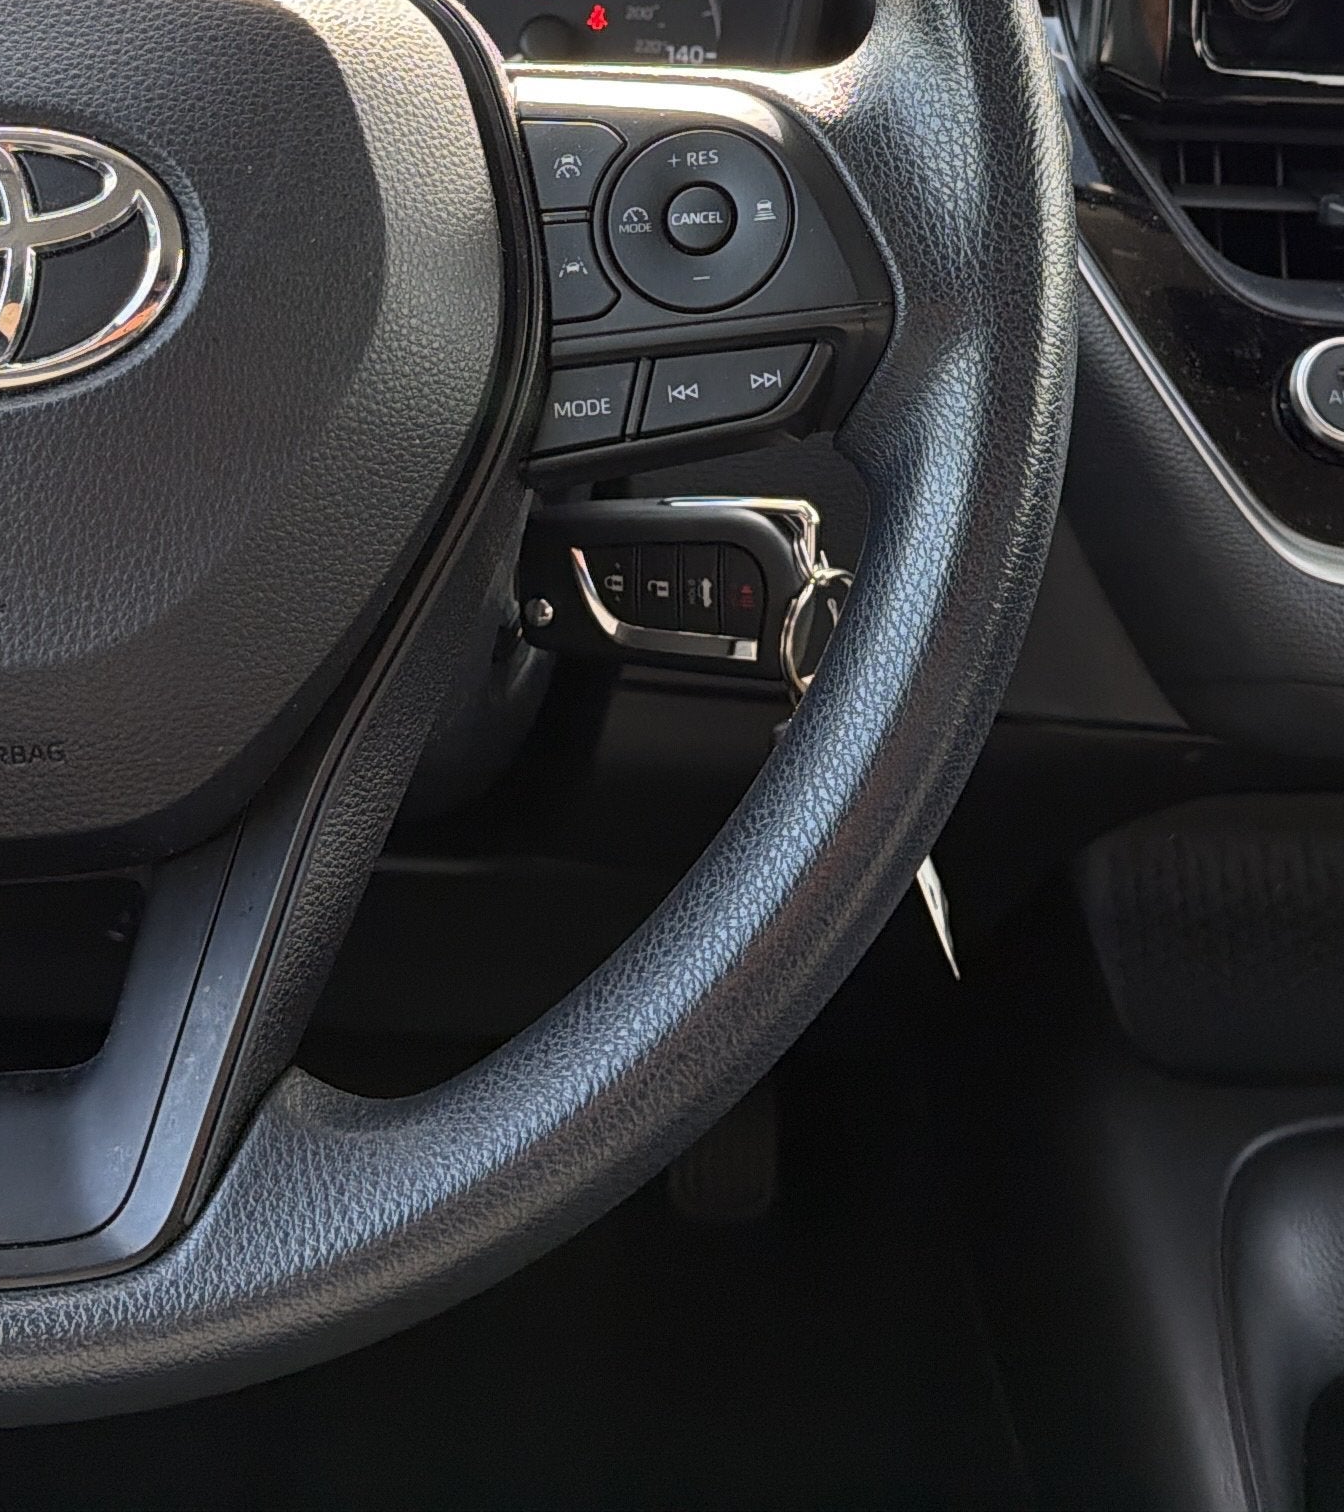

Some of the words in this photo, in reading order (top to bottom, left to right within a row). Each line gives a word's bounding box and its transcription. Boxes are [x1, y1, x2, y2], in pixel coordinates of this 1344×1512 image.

[665, 45, 704, 65] 140
[686, 148, 721, 168] RES
[618, 222, 653, 234] MODE
[671, 211, 725, 227] CANCEL
[554, 398, 613, 420] MODE
